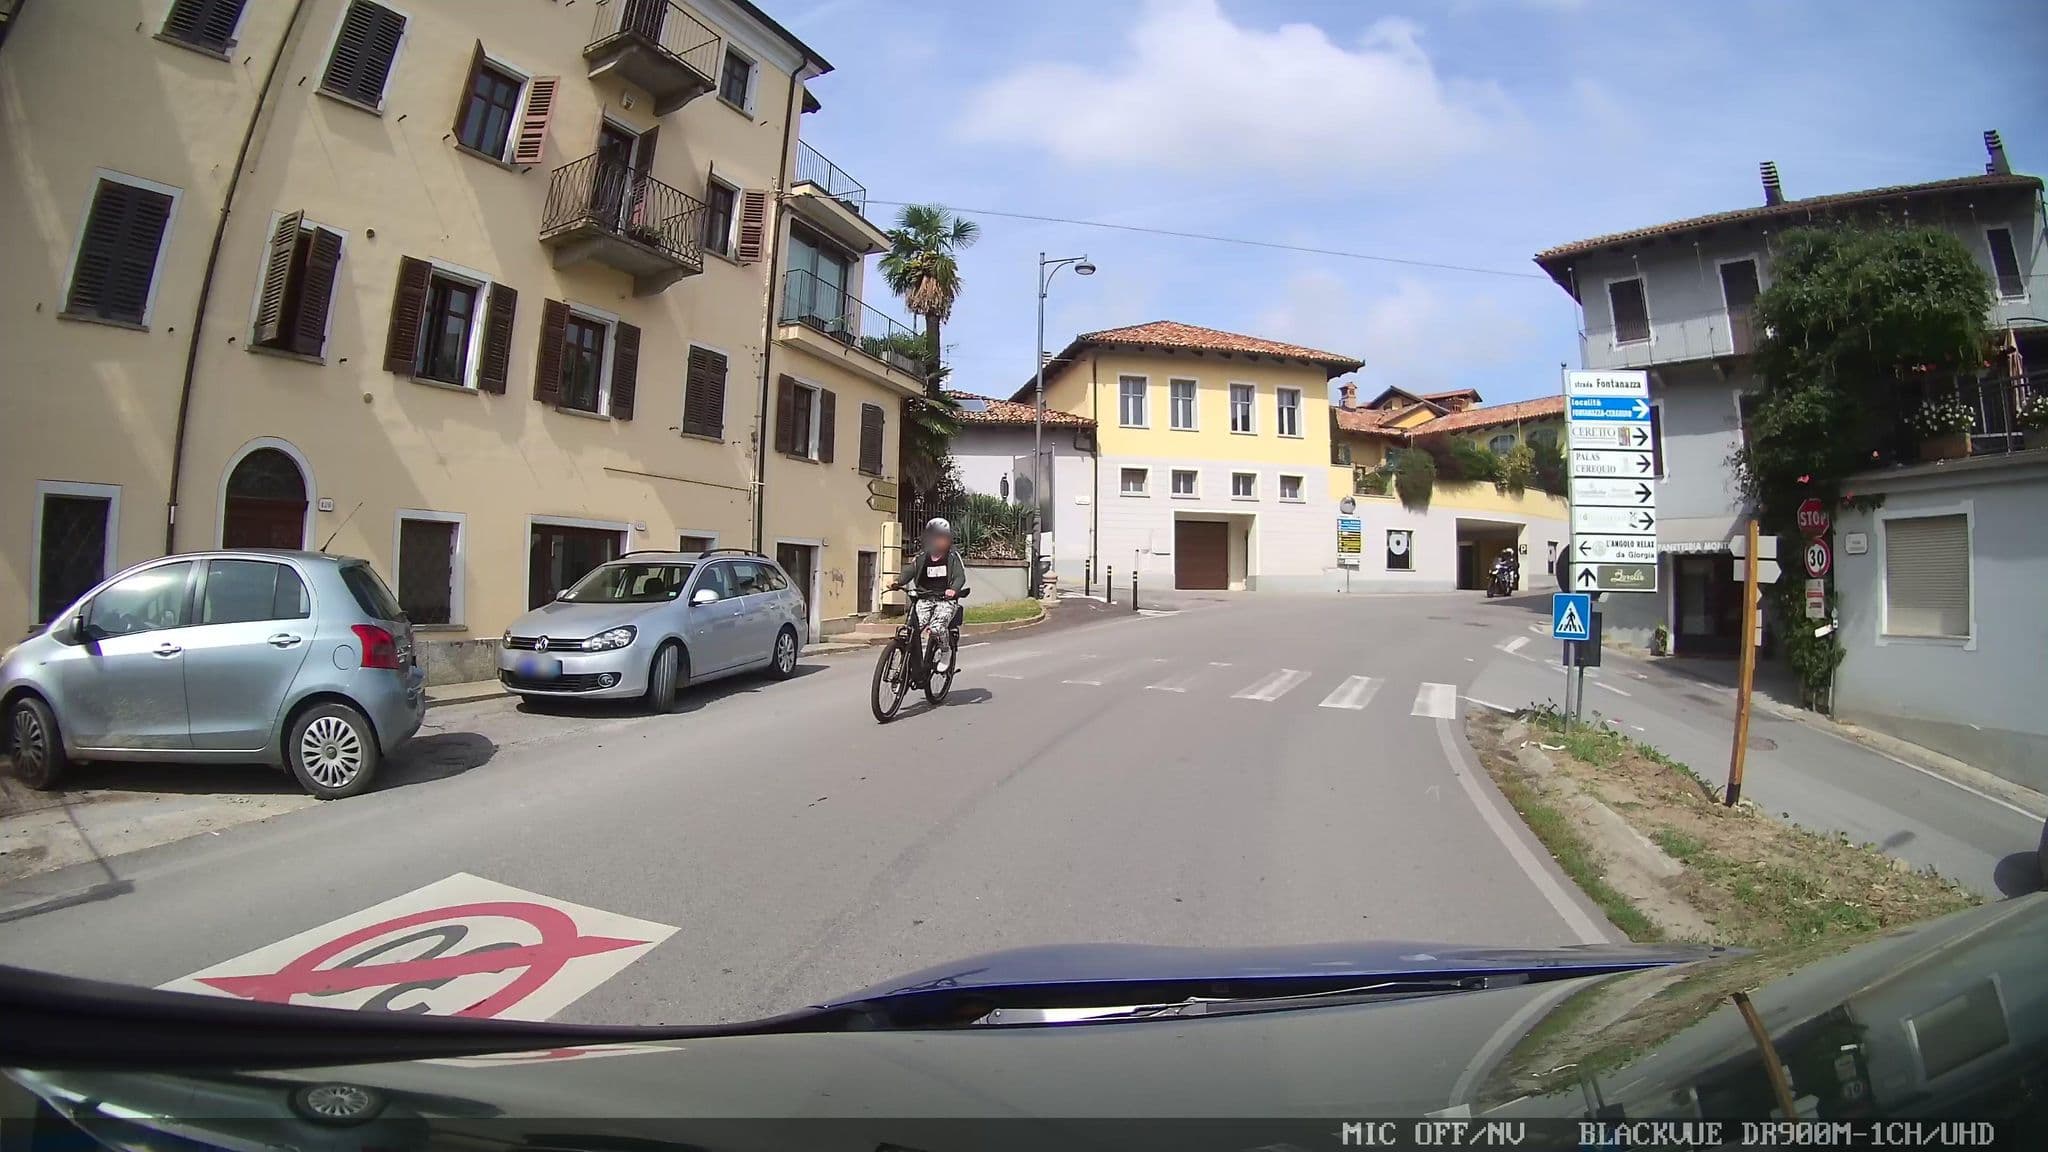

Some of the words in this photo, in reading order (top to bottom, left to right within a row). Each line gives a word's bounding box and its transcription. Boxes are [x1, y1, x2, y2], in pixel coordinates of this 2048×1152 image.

[1596, 378, 1641, 389] Fontanazza
[1576, 453, 1600, 461] PALAS
[1575, 465, 1617, 474] CEREQUIO
[1800, 511, 1827, 526] STOP
[1606, 540, 1635, 548] L'ANGOLO
[1637, 540, 1654, 548] RELAX
[1809, 549, 1825, 567] 30
